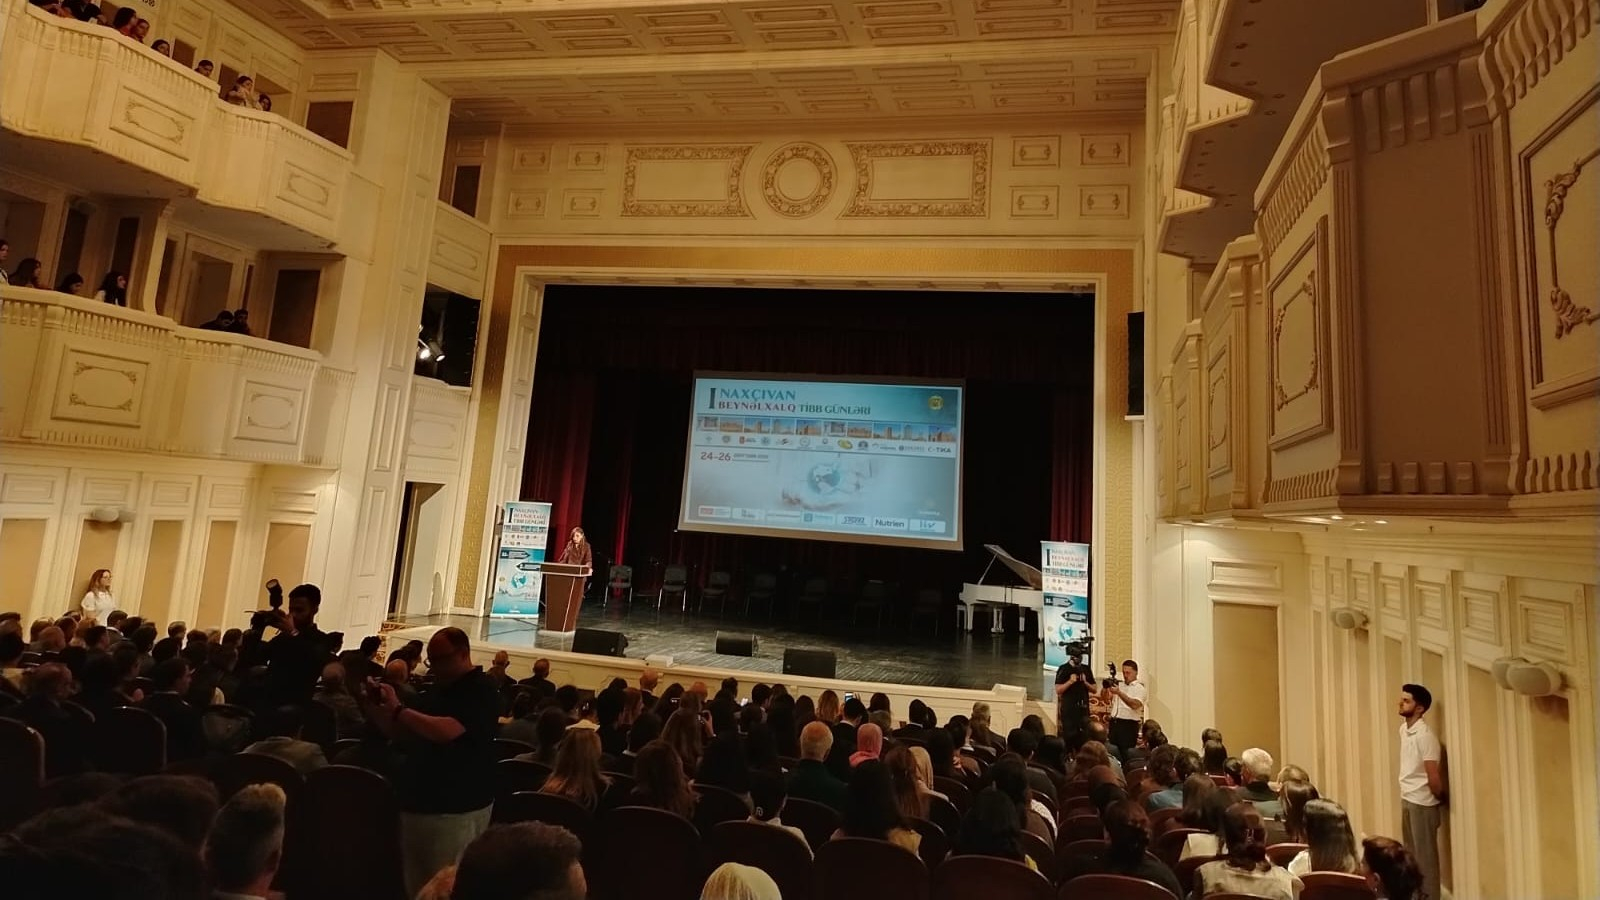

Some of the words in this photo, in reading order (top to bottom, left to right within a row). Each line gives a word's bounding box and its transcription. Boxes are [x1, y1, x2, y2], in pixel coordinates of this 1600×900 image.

[720, 388, 796, 402] NAXÇIVAN
[718, 401, 796, 413] BEYNƏLXALQ
[700, 451, 731, 461] 24-26
[875, 519, 905, 528] Nutrien
